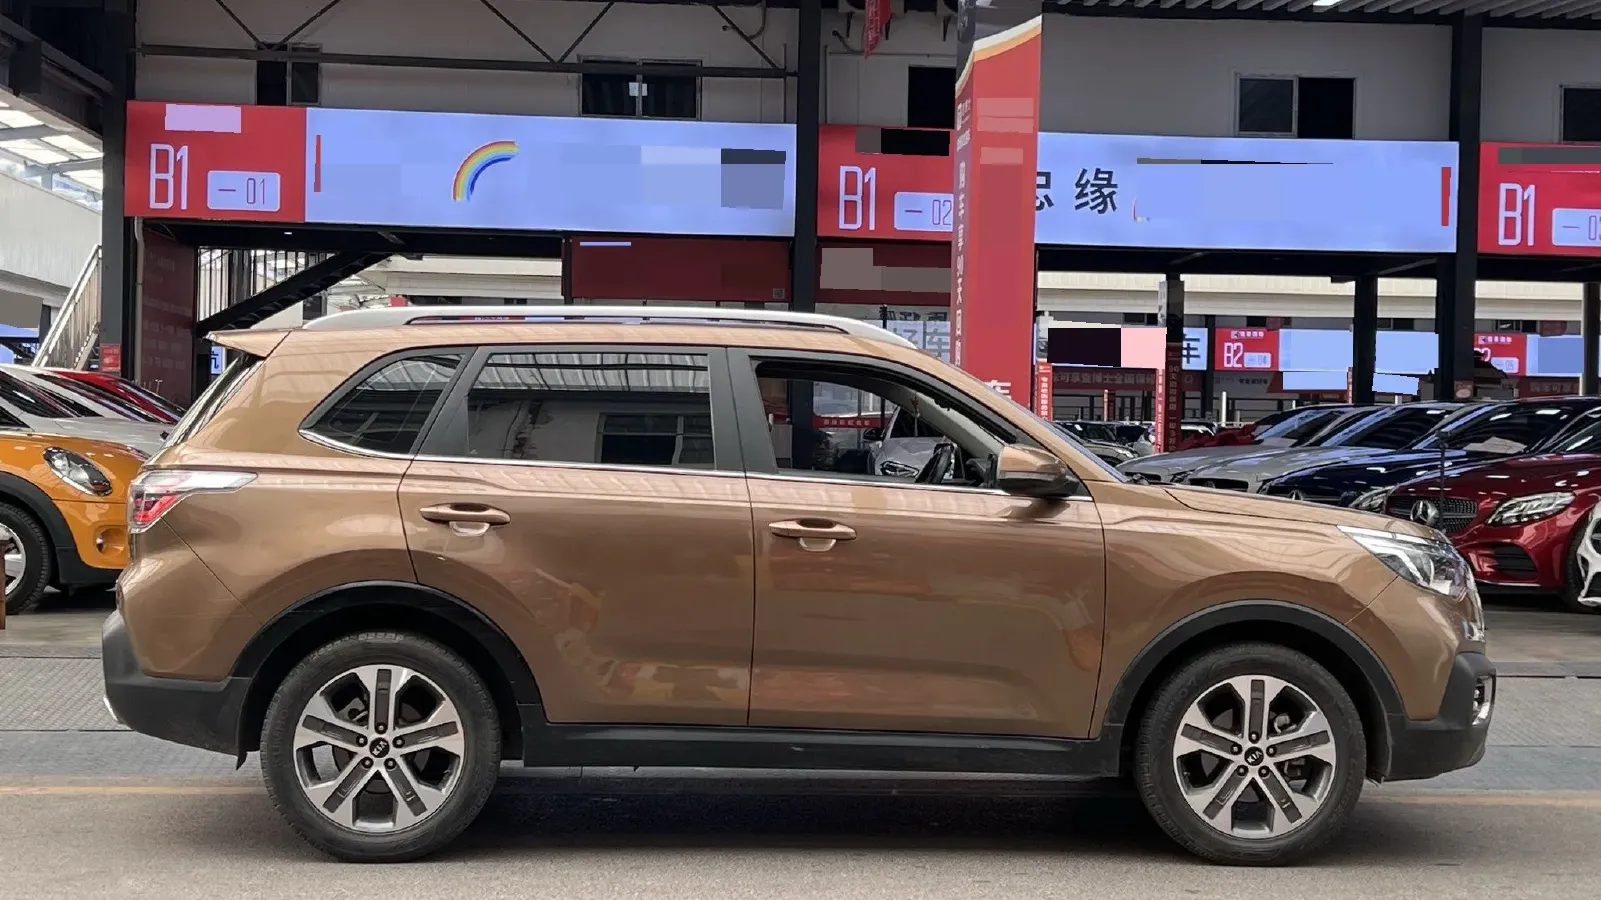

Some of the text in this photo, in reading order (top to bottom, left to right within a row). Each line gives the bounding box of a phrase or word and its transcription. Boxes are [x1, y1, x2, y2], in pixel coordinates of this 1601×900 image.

[150, 143, 189, 210] B1
[839, 165, 877, 231] B1
[1498, 182, 1536, 247] B1
[1224, 342, 1243, 368] B2
[372, 740, 388, 756] KIA
[1247, 750, 1263, 764] KIA
